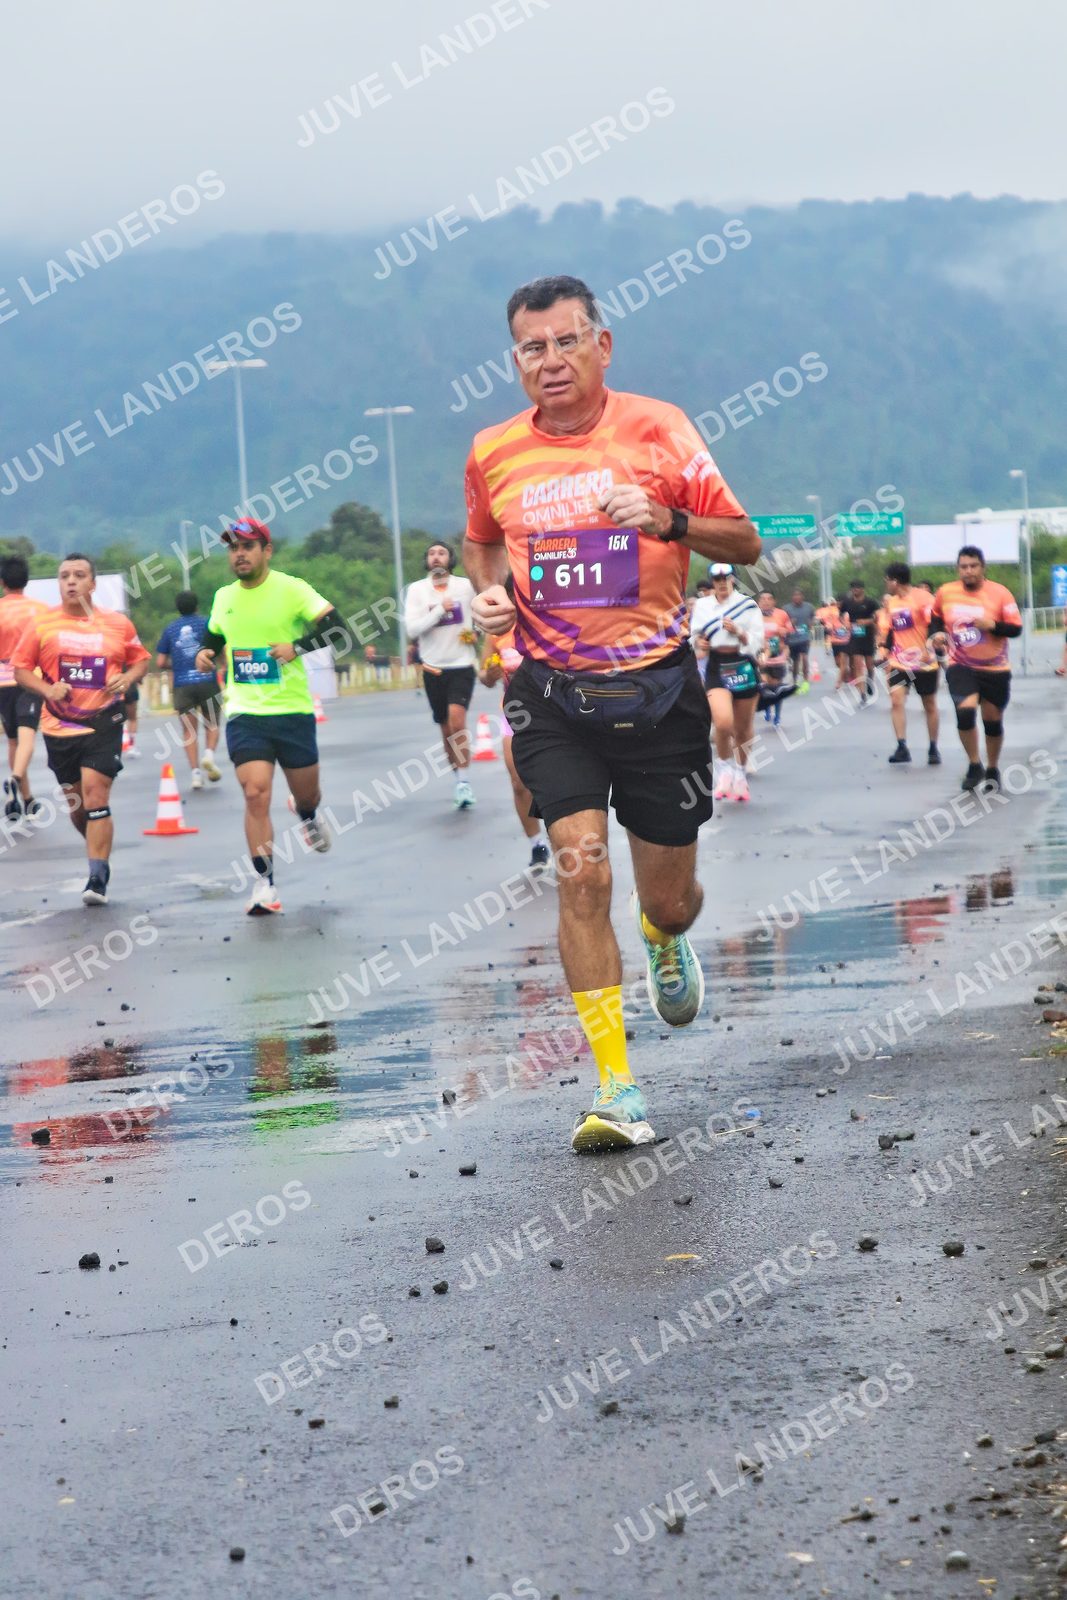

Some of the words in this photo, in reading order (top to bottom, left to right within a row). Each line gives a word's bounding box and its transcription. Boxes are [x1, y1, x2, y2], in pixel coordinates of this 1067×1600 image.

[521, 468, 613, 508] CARRERA
[522, 499, 594, 525] OMNILIFE
[533, 537, 577, 553] CARRERA
[533, 550, 567, 561] OMNILIFE
[555, 562, 602, 588] 611
